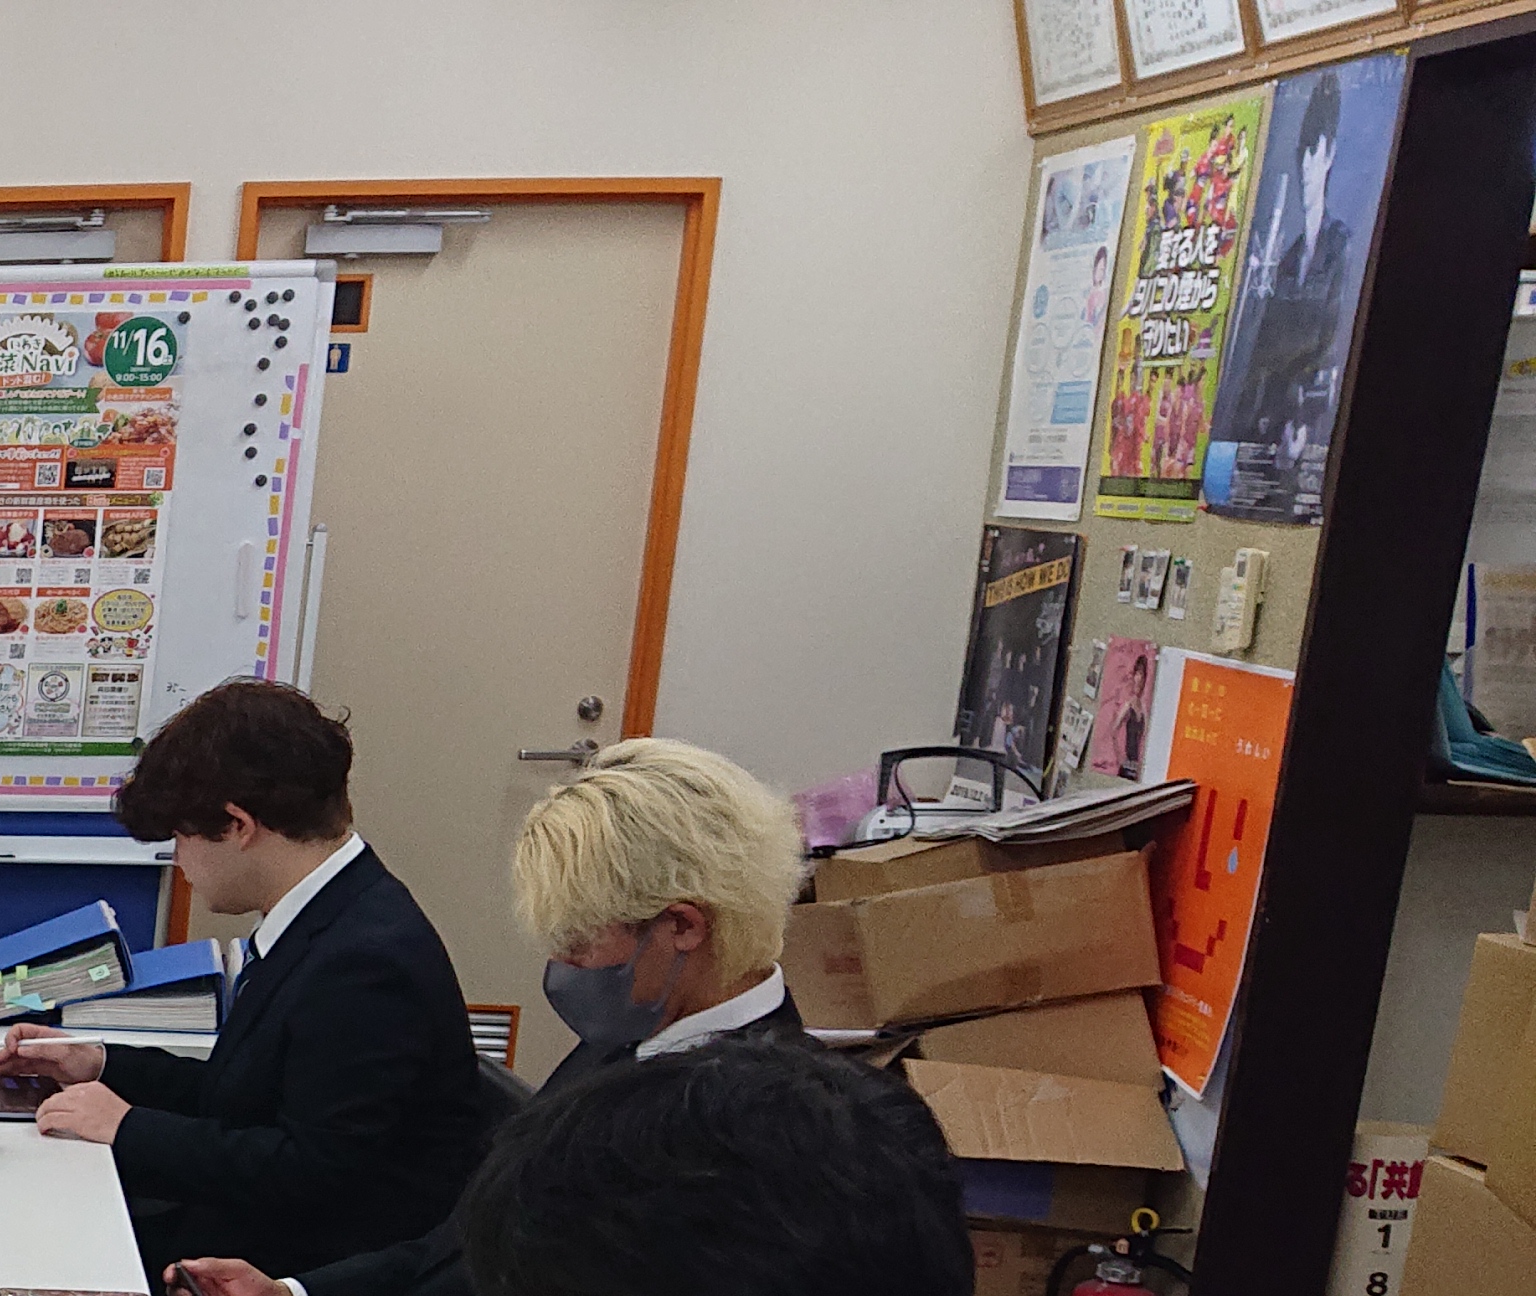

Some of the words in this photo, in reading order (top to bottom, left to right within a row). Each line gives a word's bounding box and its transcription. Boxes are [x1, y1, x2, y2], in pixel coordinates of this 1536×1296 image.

[1158, 225, 1221, 270] 愛する人を
[1122, 269, 1220, 316] タバコの煙から
[9, 337, 44, 351] いわき
[113, 327, 167, 367] 11/16
[1142, 316, 1189, 358] 守りたい
[1377, 1224, 1392, 1249] 1
